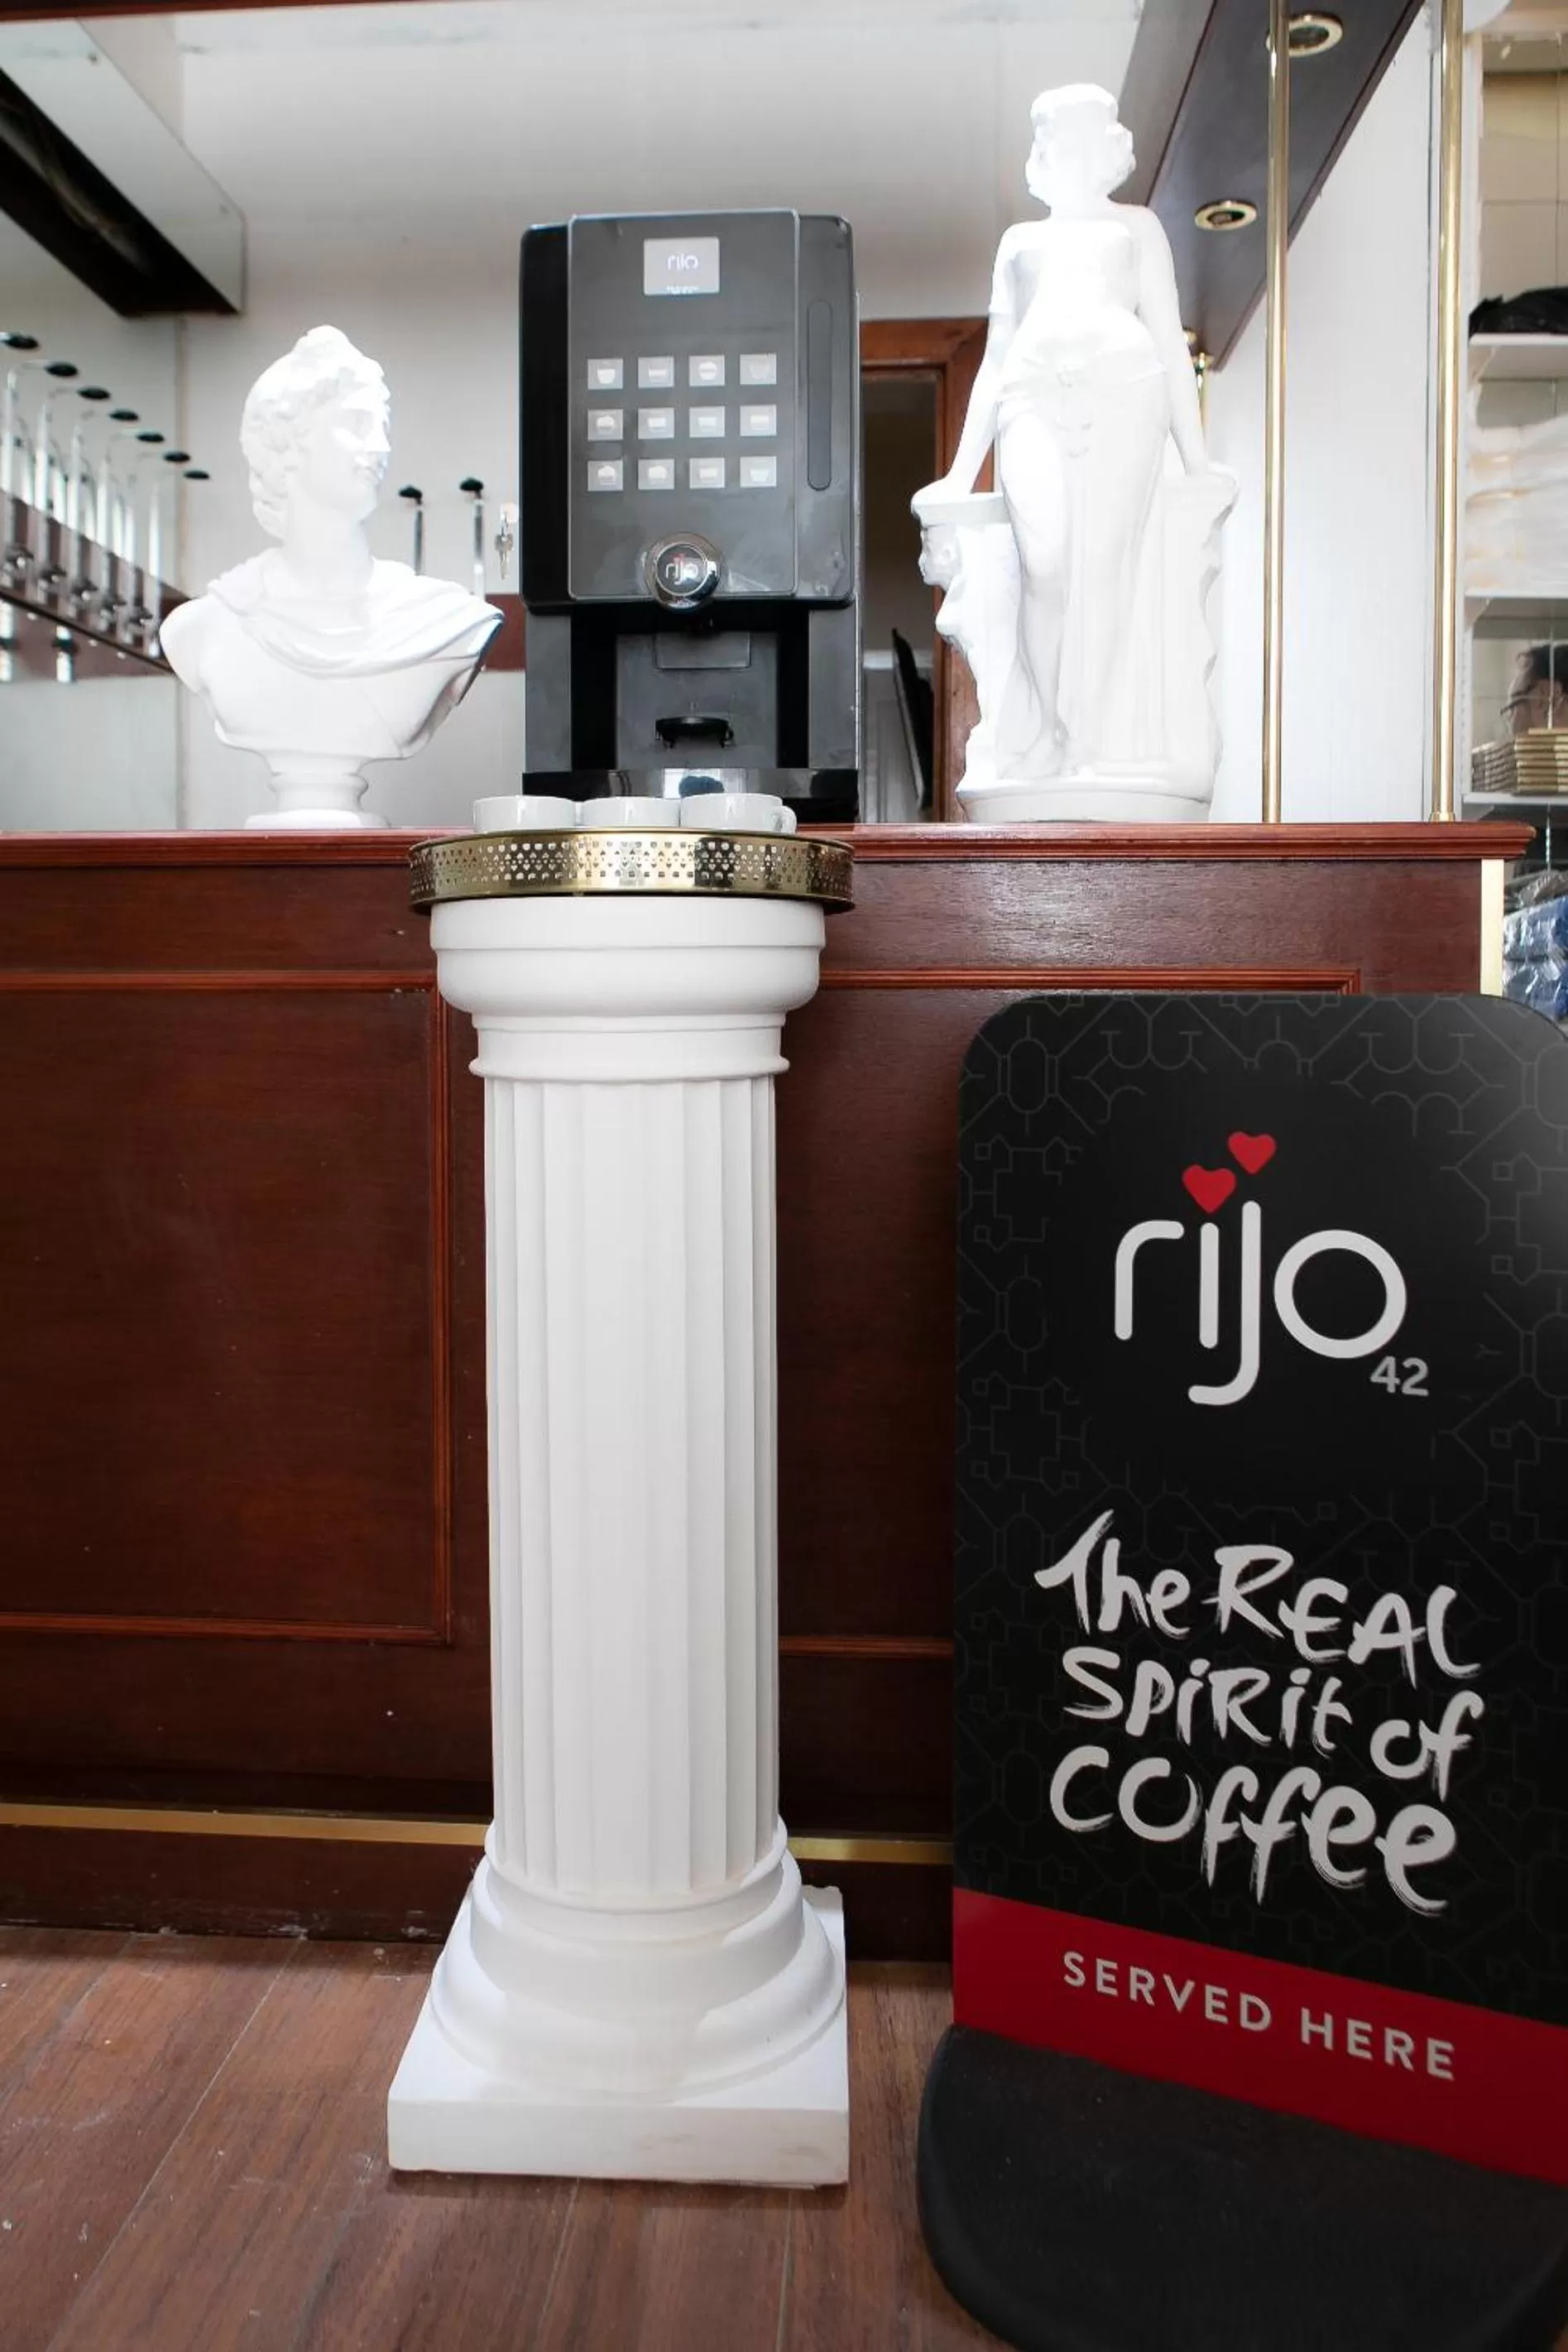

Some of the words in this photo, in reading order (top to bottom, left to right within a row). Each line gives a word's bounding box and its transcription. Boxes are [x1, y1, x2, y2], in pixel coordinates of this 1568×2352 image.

[665, 554, 699, 585] rijo
[1114, 1200, 1407, 1406] rijo
[1369, 1356, 1430, 1397] 42
[1033, 1509, 1192, 1638] The
[1201, 1544, 1481, 1689] REAL
[1369, 1691, 1484, 1802] of
[1062, 1951, 1272, 2032] SERVED
[1300, 2009, 1455, 2081] HERE
